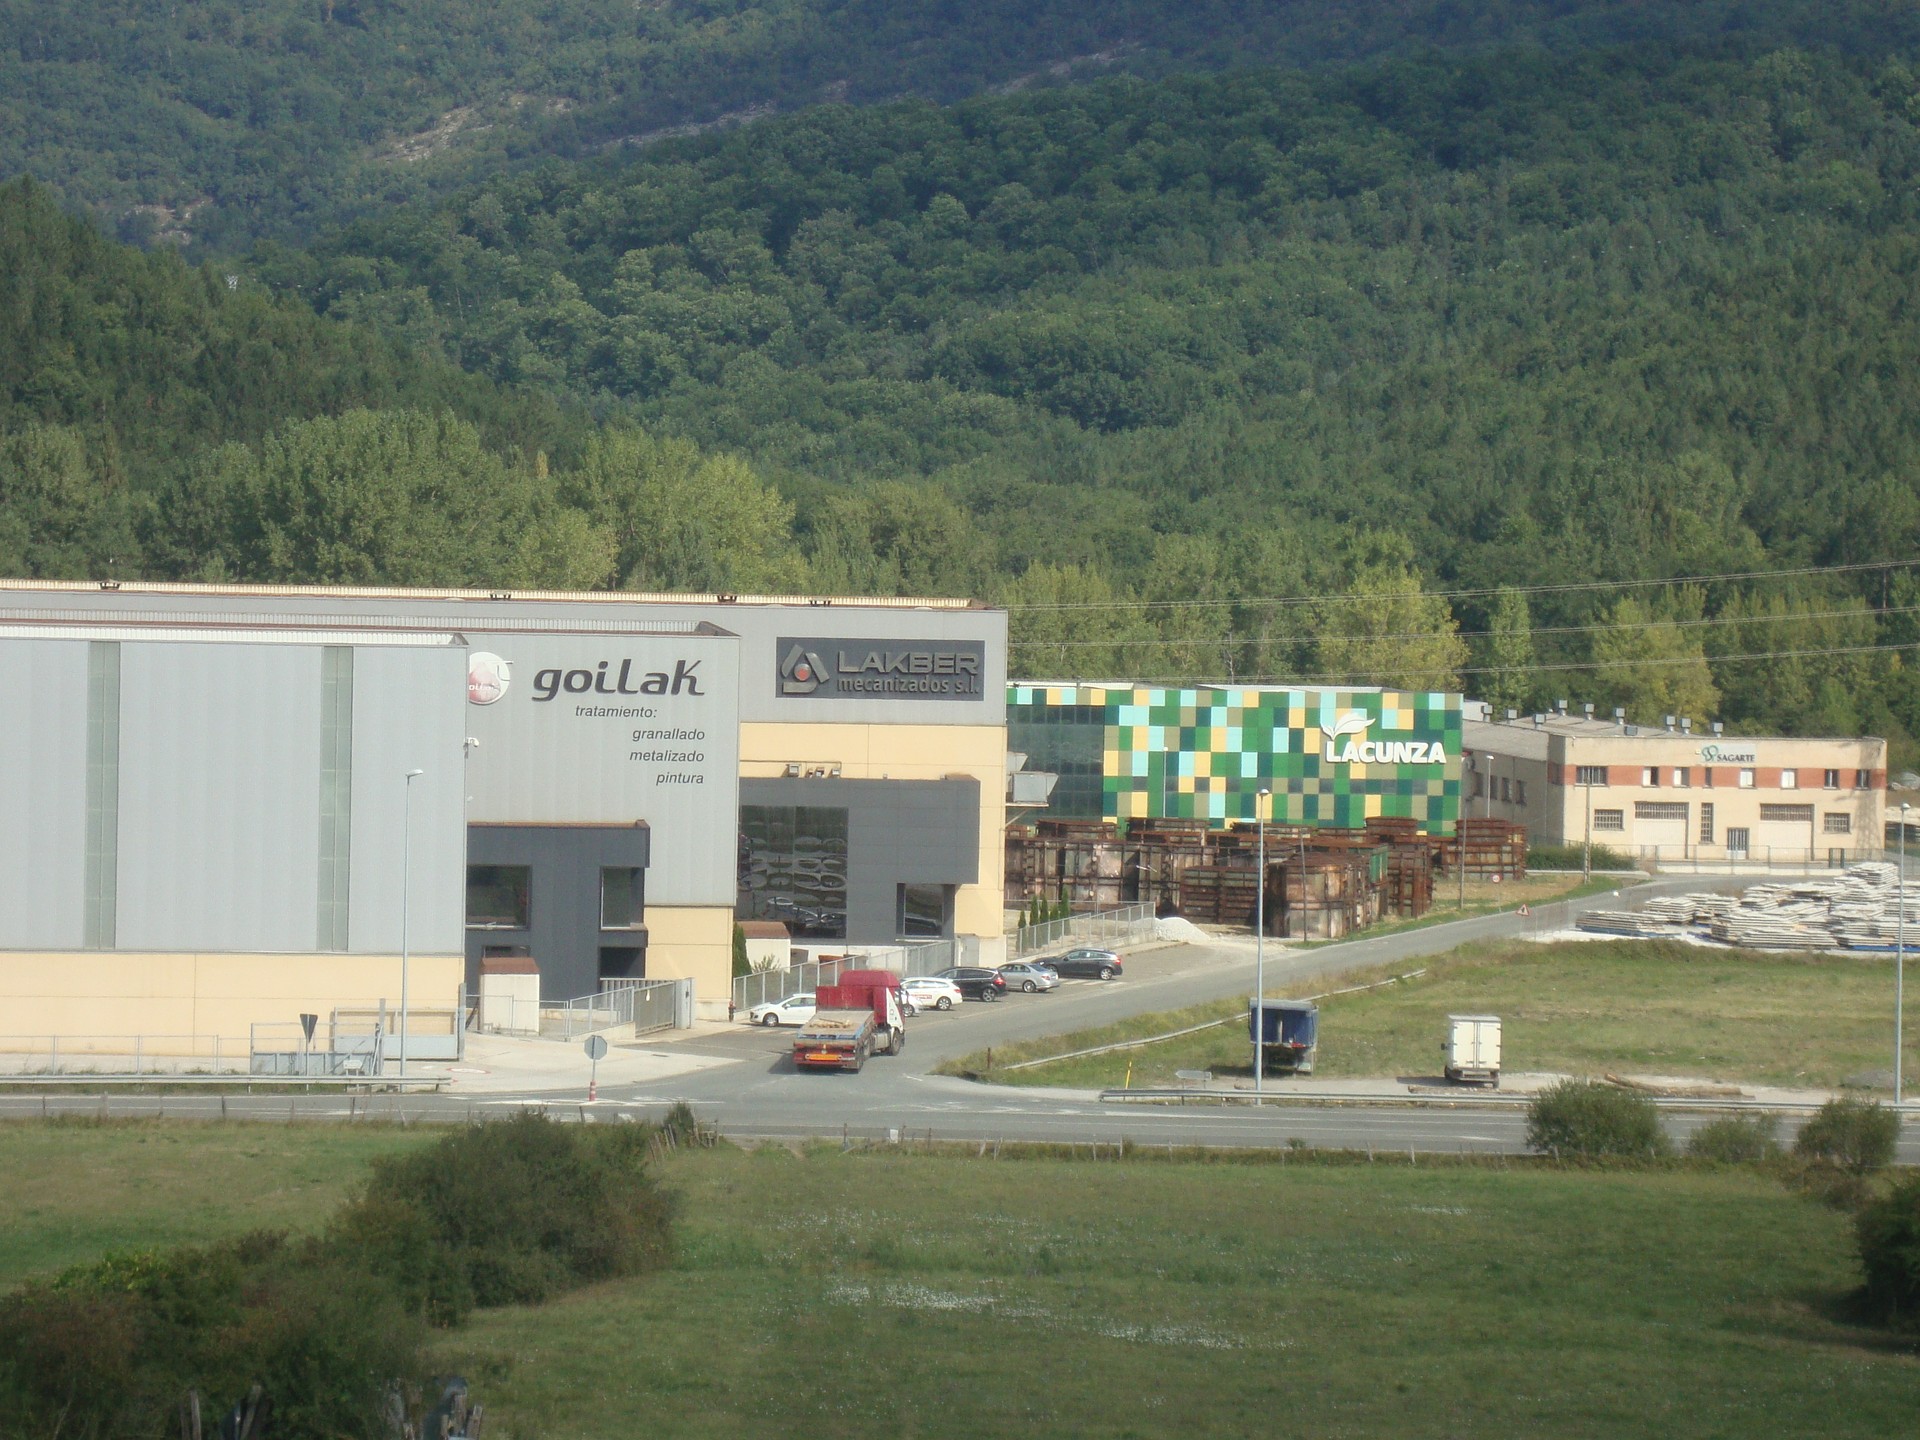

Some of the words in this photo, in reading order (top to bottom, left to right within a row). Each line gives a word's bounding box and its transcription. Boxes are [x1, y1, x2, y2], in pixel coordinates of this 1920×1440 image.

[837, 650, 979, 674] LAKBER
[837, 675, 949, 693] mecanizados
[574, 704, 658, 718] tratamiento:
[631, 727, 706, 741] granallado
[628, 749, 705, 763] metalizado
[1325, 741, 1447, 764] LACUNZA
[1716, 753, 1756, 762] SAGARTE
[655, 771, 705, 786] pintura
